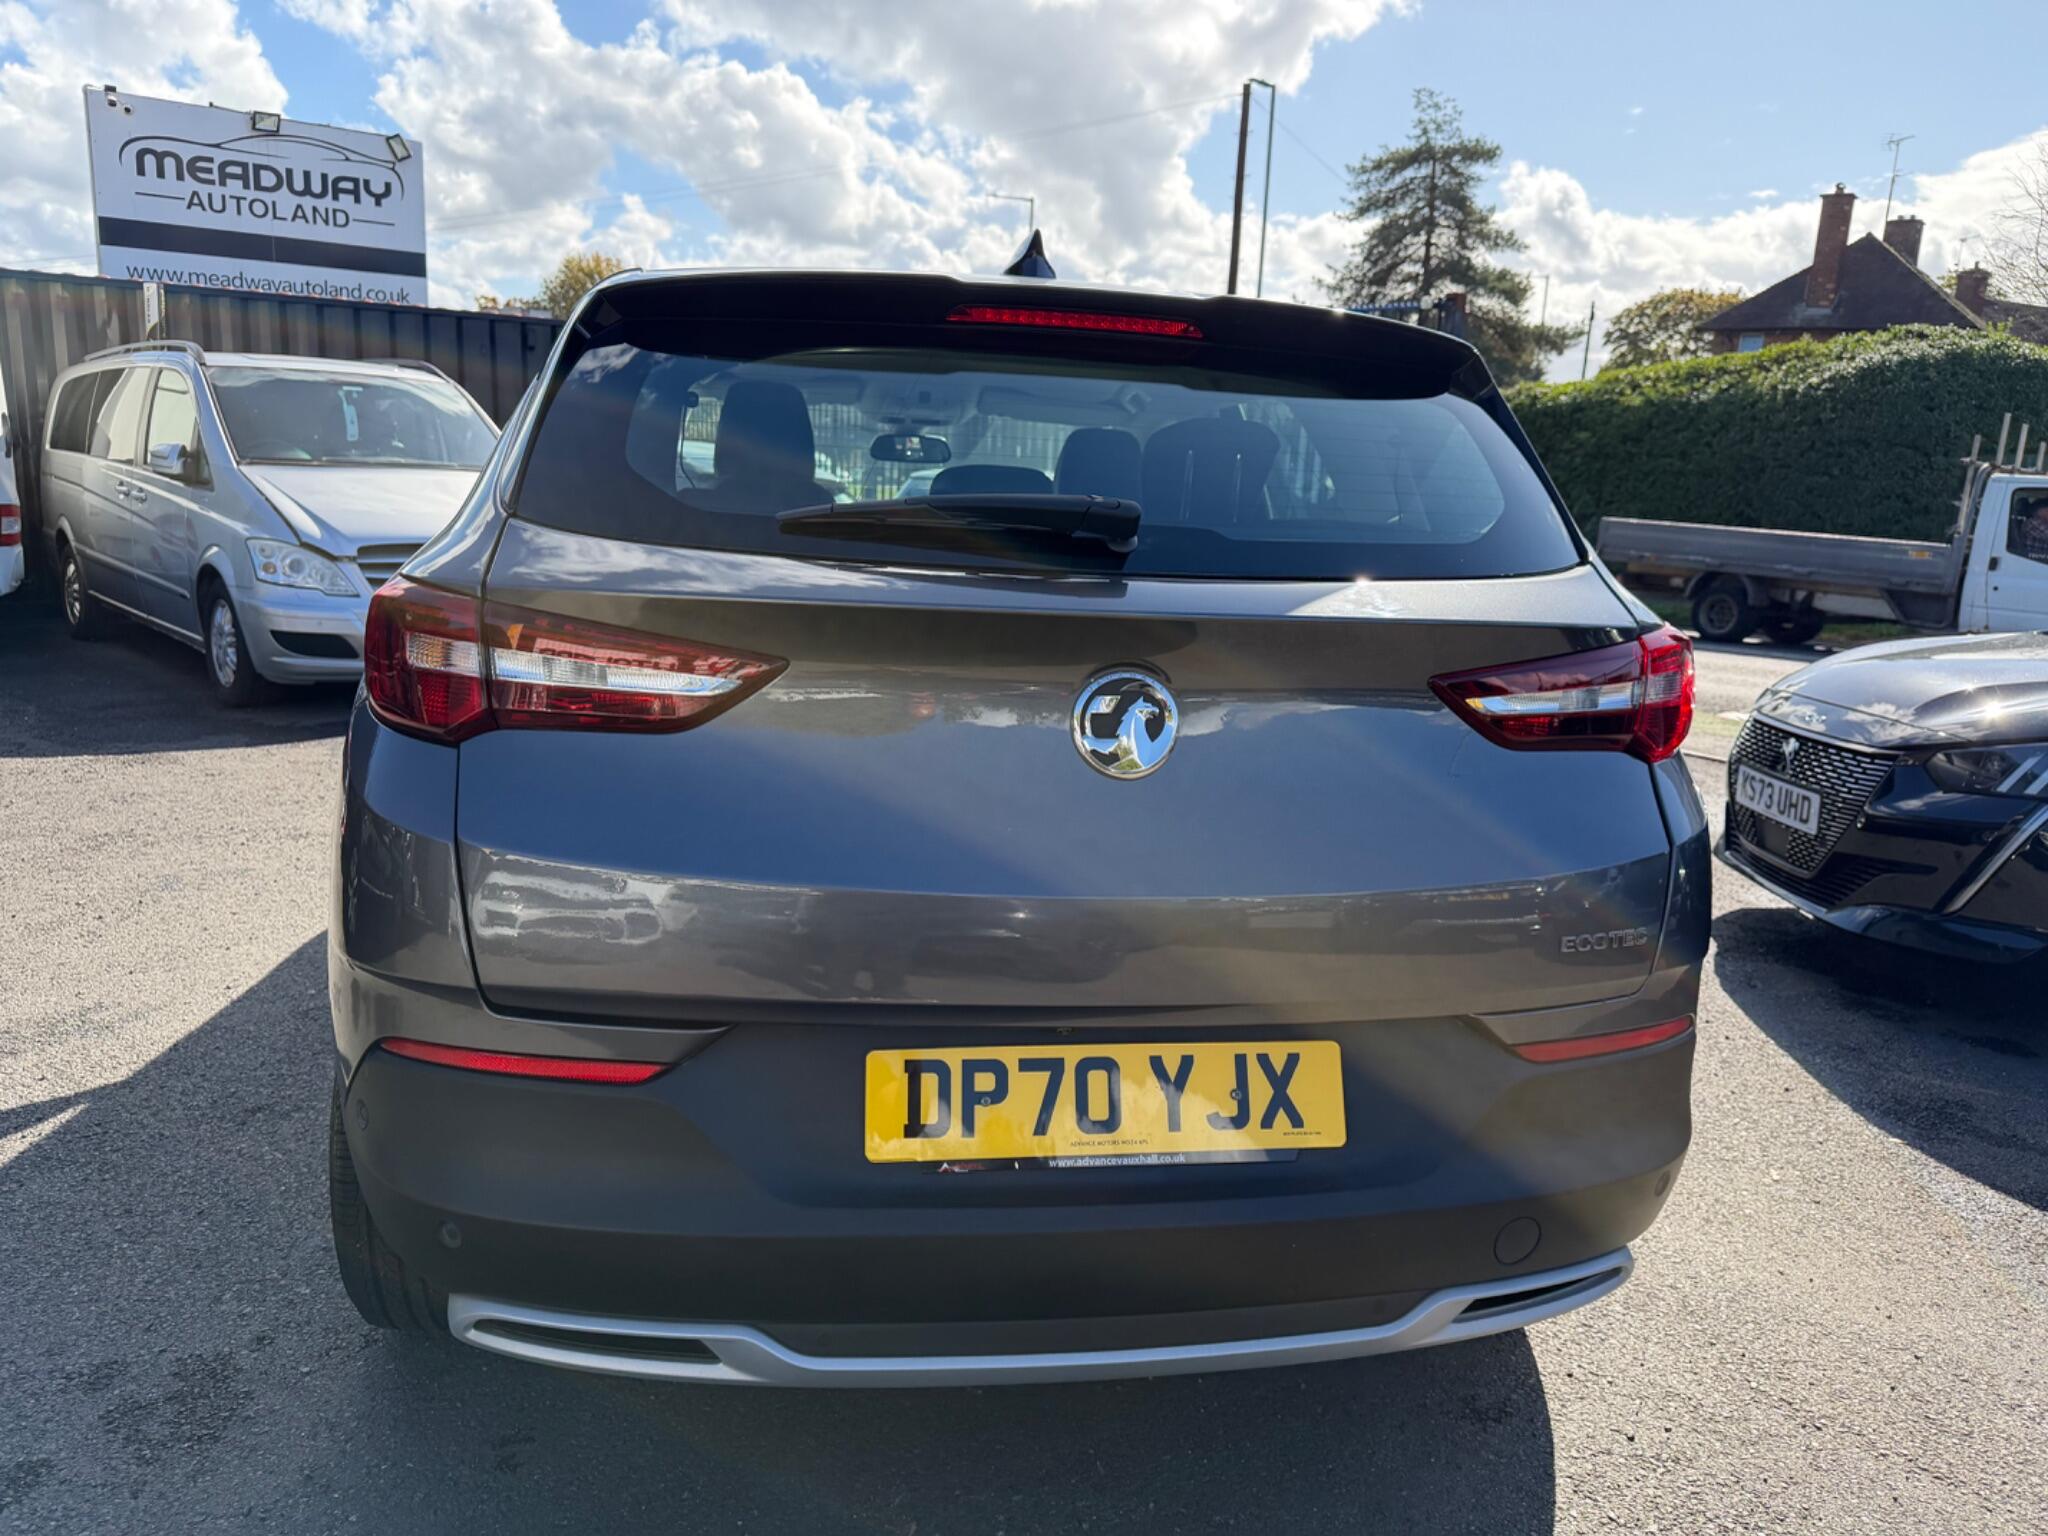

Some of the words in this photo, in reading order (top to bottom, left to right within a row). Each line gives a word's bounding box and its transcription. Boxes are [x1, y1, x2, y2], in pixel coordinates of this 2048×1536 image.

[135, 147, 393, 207] MEADWAY
[186, 190, 351, 229] AUTOLAND
[1777, 786, 1812, 825] UHD
[1561, 927, 1648, 953] ECOTEC
[903, 1056, 1122, 1138] DP70
[1149, 1053, 1305, 1133] YJX
[1049, 1153, 1186, 1168] www.advancevauxhall.co.uk
